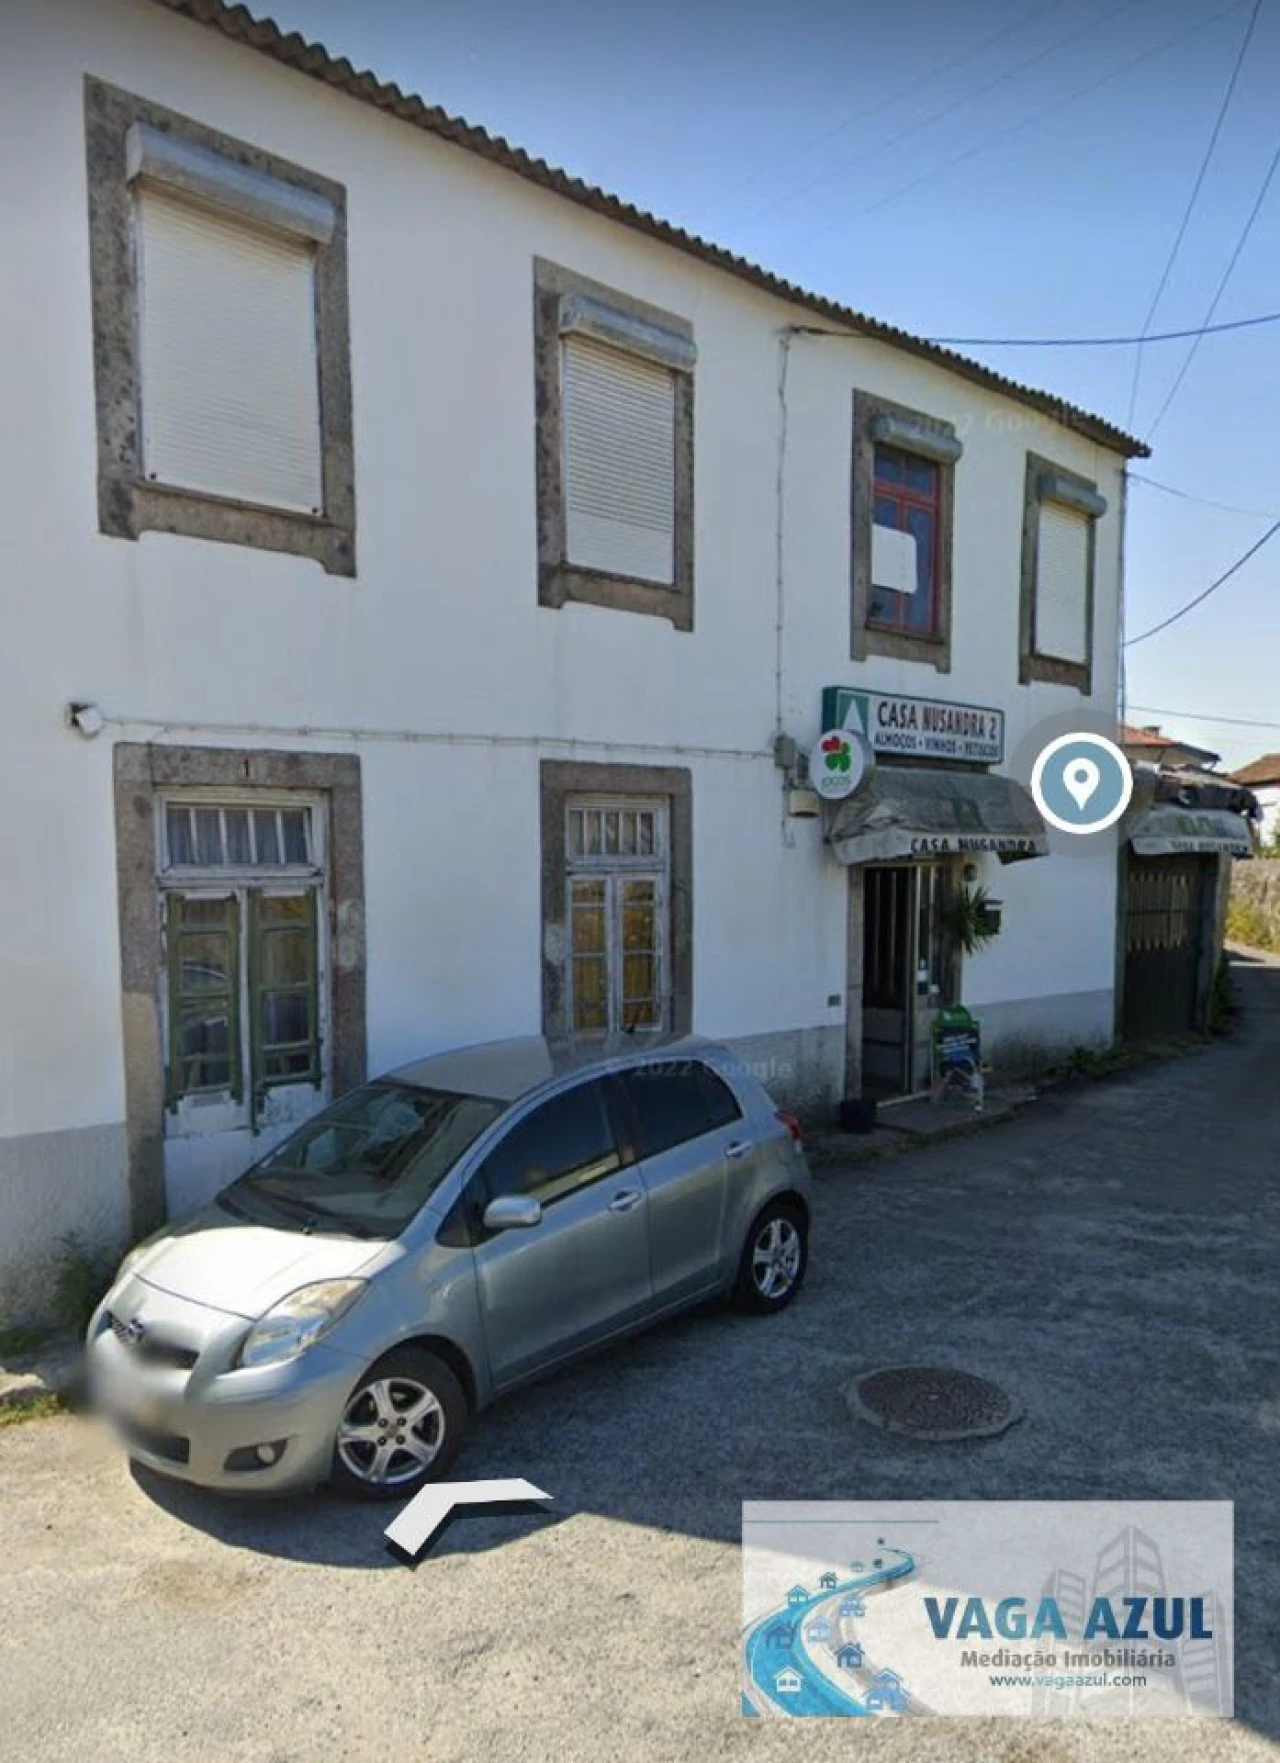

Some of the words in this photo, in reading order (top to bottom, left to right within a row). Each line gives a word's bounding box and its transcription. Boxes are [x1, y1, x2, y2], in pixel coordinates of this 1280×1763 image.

[877, 701, 918, 729] CASA
[989, 717, 997, 741] 2
[910, 837, 950, 852] CASA
